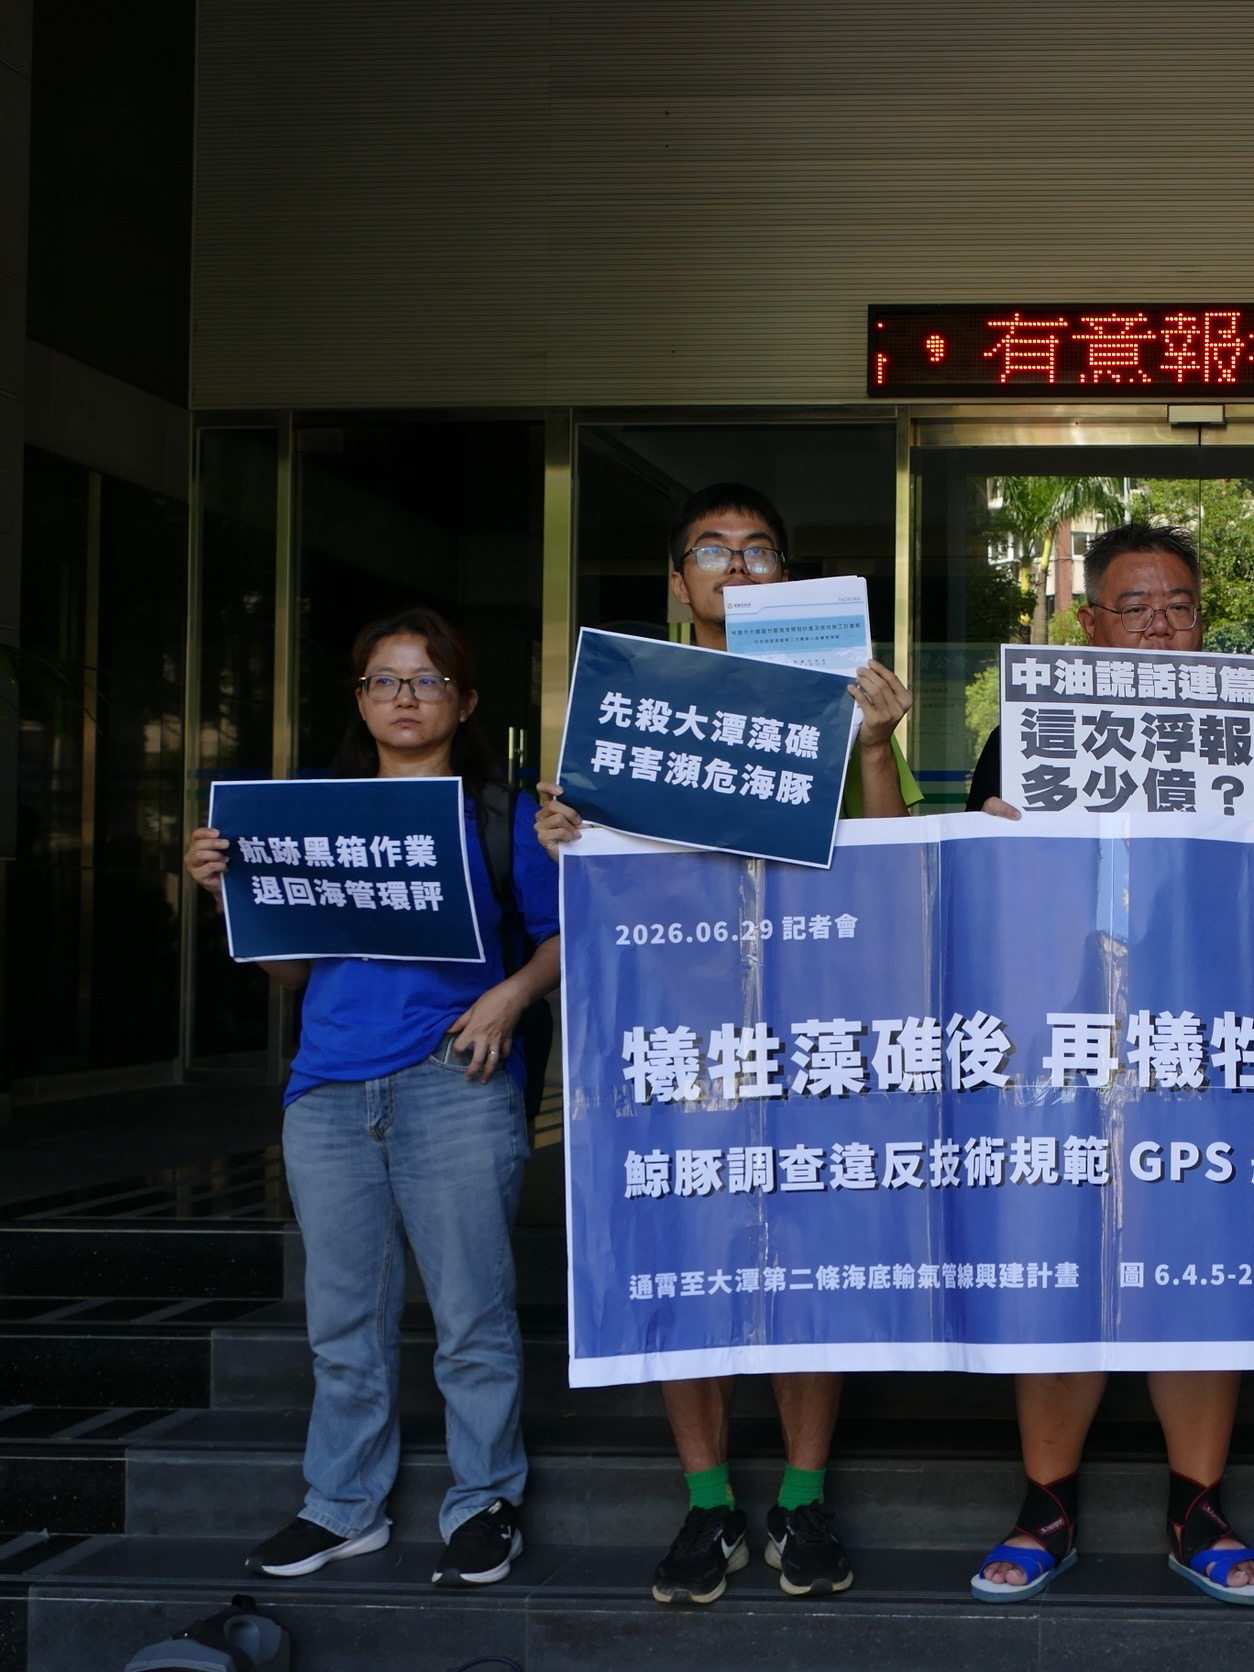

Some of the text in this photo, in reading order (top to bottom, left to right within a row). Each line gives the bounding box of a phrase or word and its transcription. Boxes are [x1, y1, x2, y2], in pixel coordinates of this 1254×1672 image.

[598, 691, 821, 760] 先殺大潭藻礁
[1020, 707, 1253, 767] 這次浮報
[590, 739, 815, 806] 再害瀕危海豚
[1021, 763, 1245, 816] 多少億？
[237, 834, 438, 868] 航跡黑箱作業
[251, 875, 444, 912] 退回海管環評
[615, 913, 858, 946] 2026.06.29 記者會
[621, 1010, 1011, 1104] 犧牲藻礁後
[624, 1135, 1110, 1199] 鯨豚調查違反技術規範
[1129, 1140, 1234, 1183] GPS
[629, 1261, 1080, 1300] 通霄至大潭第二條海底輸氣管線興建計畫
[1119, 1262, 1145, 1288] 圖
[1154, 1263, 1253, 1286] 6.4.5-2
